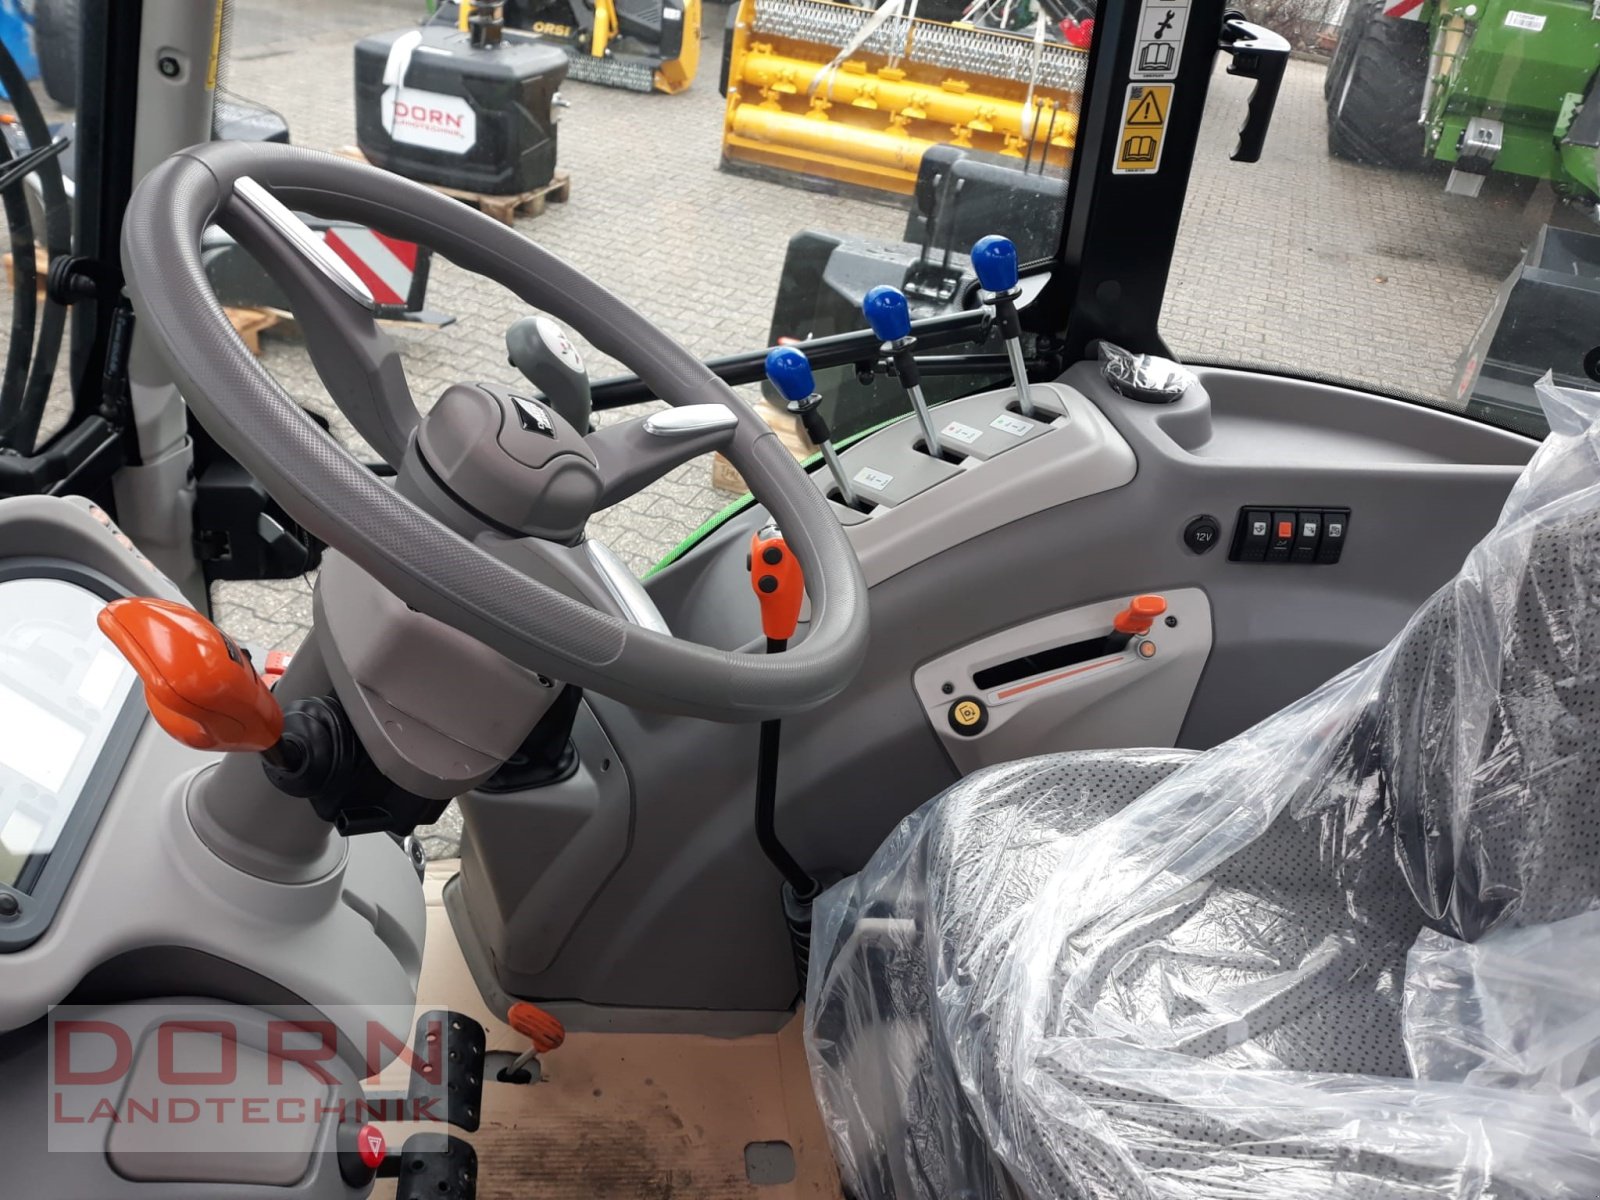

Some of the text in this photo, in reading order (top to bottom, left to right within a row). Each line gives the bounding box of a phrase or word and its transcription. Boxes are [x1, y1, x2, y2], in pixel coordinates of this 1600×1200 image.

[533, 22, 570, 36] ORSI
[394, 101, 461, 128] DORN
[1196, 533, 1212, 541] 12V
